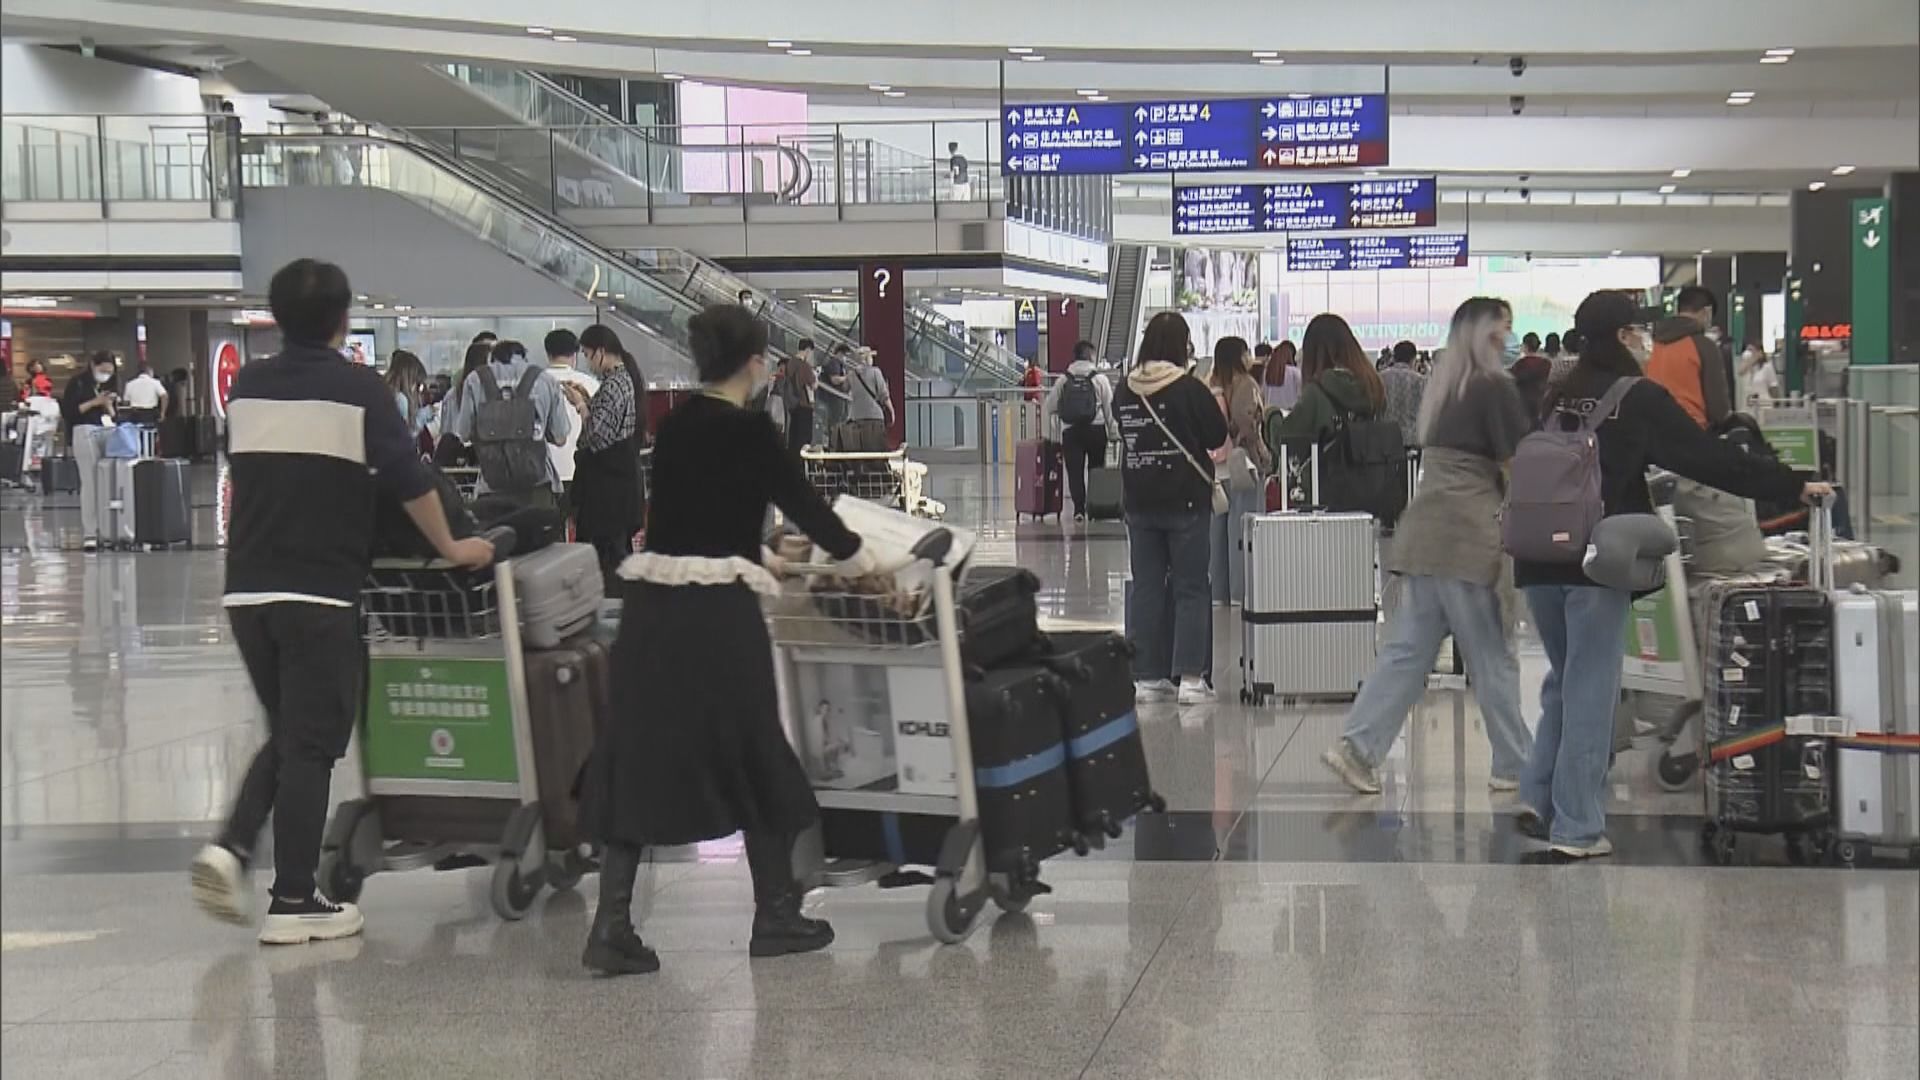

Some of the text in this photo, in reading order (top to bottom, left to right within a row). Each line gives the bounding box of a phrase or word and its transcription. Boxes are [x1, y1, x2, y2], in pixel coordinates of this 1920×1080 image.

[1066, 107, 1080, 126] A
[1199, 103, 1211, 121] 4
[1303, 185, 1313, 198] A
[1395, 198, 1404, 210] 4
[1018, 297, 1036, 316] A
